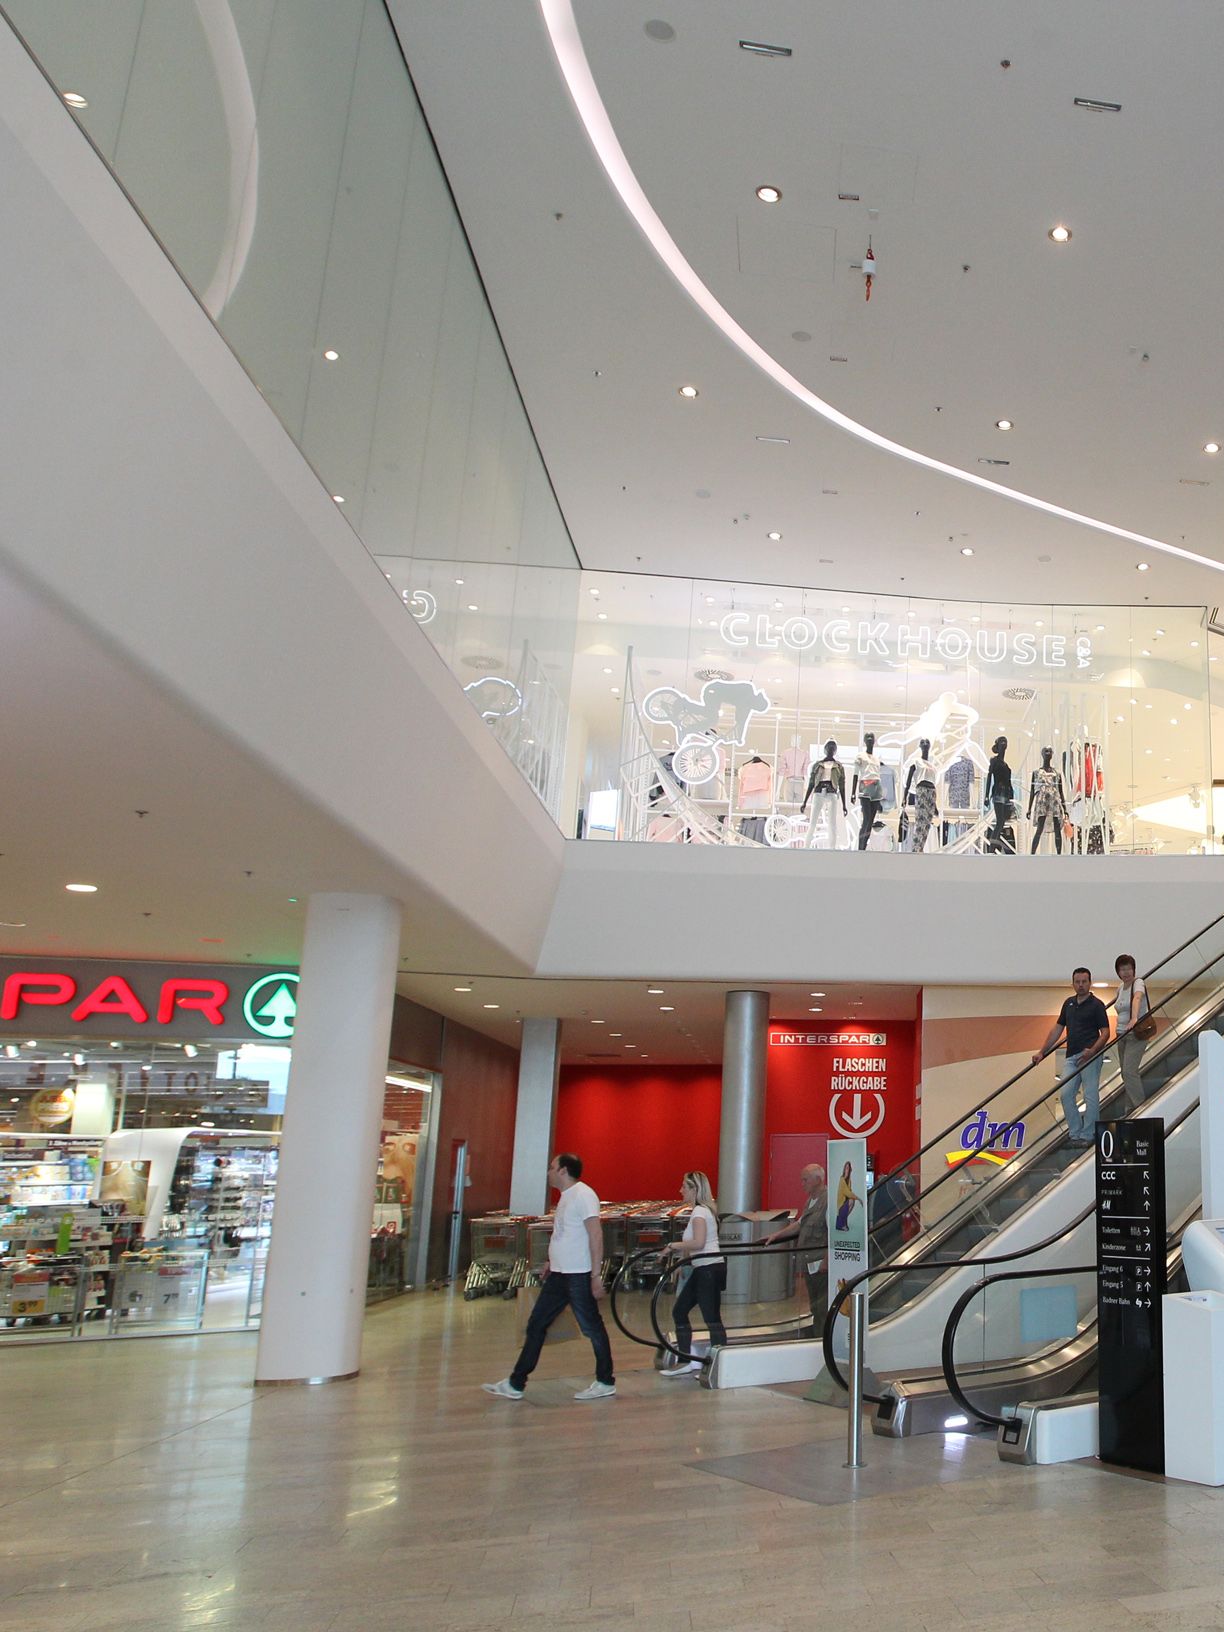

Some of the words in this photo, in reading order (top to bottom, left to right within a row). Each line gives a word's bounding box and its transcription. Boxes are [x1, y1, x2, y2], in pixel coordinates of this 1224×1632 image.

[720, 611, 1067, 669] CLOCKHOUSE
[1, 972, 229, 1025] PAR
[779, 1034, 870, 1045] INTERSPAR
[833, 1058, 886, 1072] FLASCHEN
[831, 1075, 887, 1091] RÜCKGABE
[960, 1110, 1026, 1151] dm
[1101, 1130, 1114, 1159] 0
[1101, 1171, 1116, 1180] CCC
[834, 1241, 861, 1249] UNEXPECTED
[833, 1251, 861, 1262] SHOPPING
